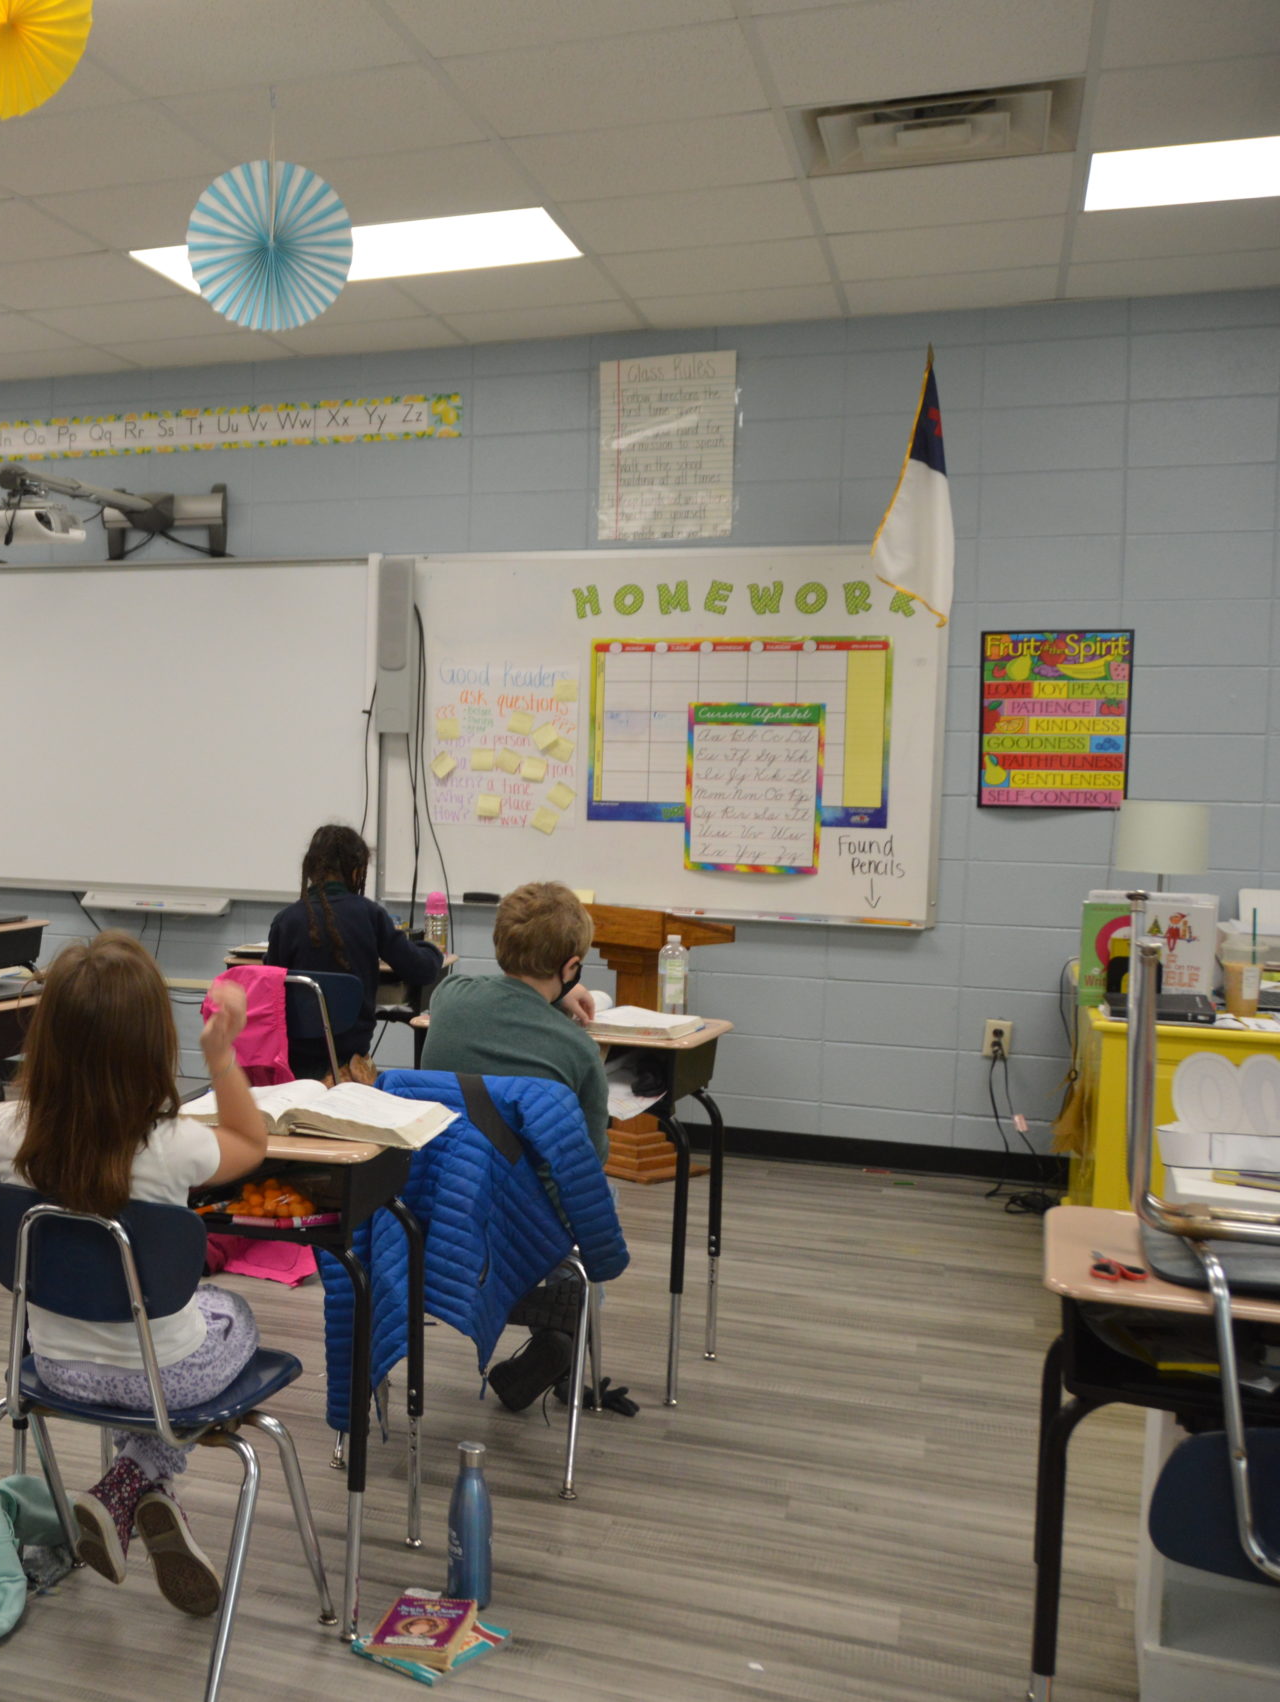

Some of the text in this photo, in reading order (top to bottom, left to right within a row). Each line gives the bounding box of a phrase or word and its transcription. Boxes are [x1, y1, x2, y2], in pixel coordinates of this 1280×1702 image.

[628, 354, 717, 383] Class Rules
[23, 428, 46, 446] Oo
[57, 425, 77, 449] Pp
[88, 423, 115, 448] Qq
[124, 420, 145, 440] Rr
[157, 418, 176, 438] Ss
[186, 417, 204, 436] Tt
[217, 415, 239, 434] Uu
[247, 413, 268, 432] Vv
[276, 411, 312, 430] Ww
[326, 408, 350, 428] Xx
[364, 406, 388, 433] Yy
[401, 403, 423, 423] Zz
[571, 579, 917, 620] HOMEWORK
[985, 633, 1130, 663] Fruit Spirit
[439, 656, 569, 689] Good Readers
[986, 682, 1126, 697] LOVE JOY PEACE
[460, 688, 569, 717] ask questions
[1011, 701, 1092, 714] PATIENCE
[698, 707, 813, 723] Cursive Alphabet
[1035, 718, 1121, 732] KINDNESS
[493, 735, 531, 752] person
[986, 736, 1086, 751] GOODNESS
[1002, 754, 1124, 769] FAITHFULNESS
[503, 777, 534, 796] time
[1011, 772, 1122, 787] GENTLENESS
[987, 789, 1119, 805] SELF-CONTROL
[838, 834, 895, 858] Found
[851, 857, 906, 879] Pencils
